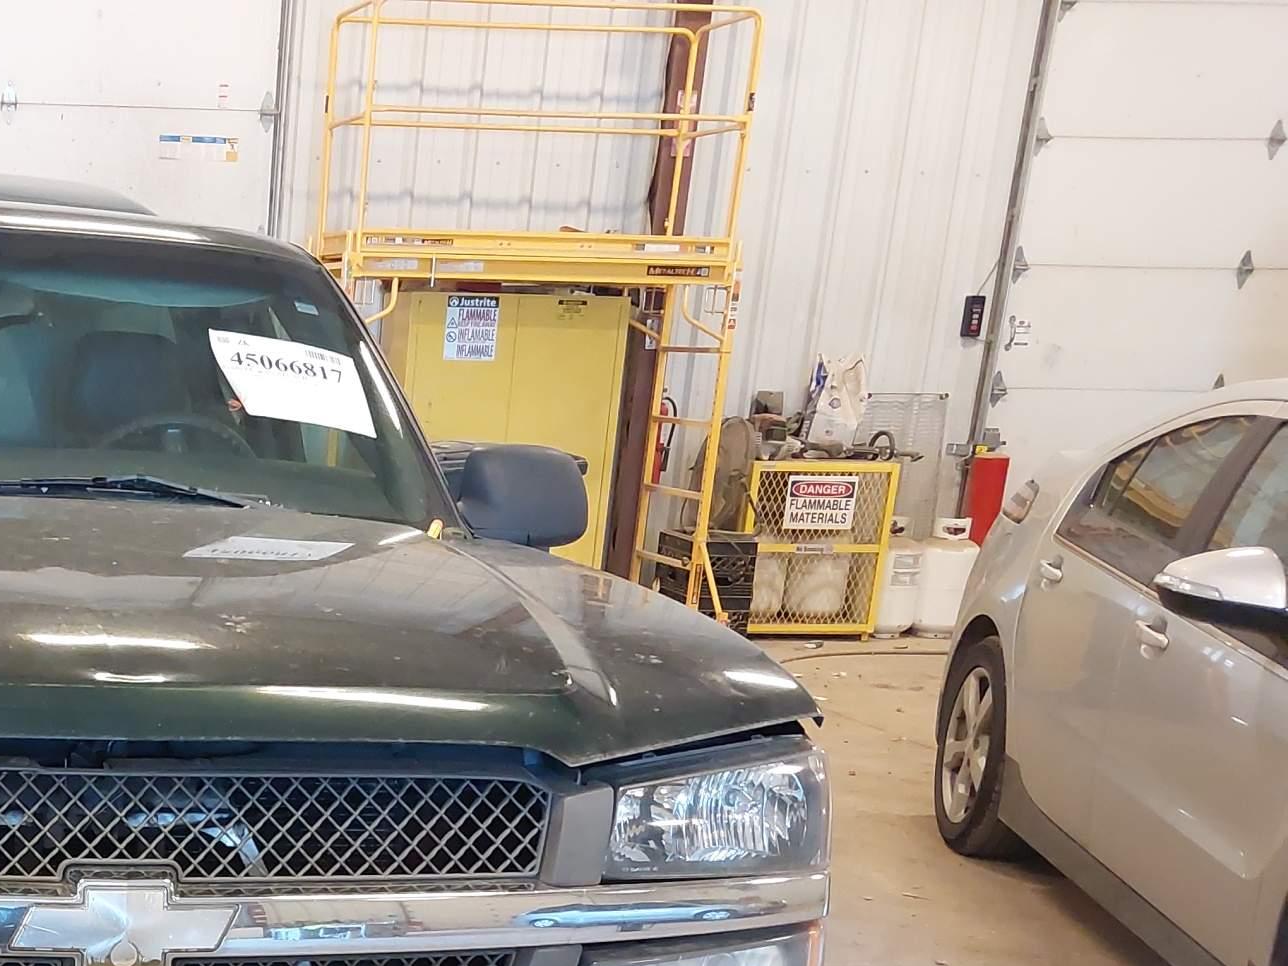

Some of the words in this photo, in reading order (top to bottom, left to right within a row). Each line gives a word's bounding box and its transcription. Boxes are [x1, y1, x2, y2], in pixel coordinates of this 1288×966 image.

[460, 297, 497, 307] Justrite
[459, 308, 497, 321] FLAMMABLE
[230, 351, 342, 383] 45066817
[799, 484, 846, 494] DANGER
[790, 498, 852, 511] FLAMMABLE
[790, 511, 848, 524] MATERIALS
